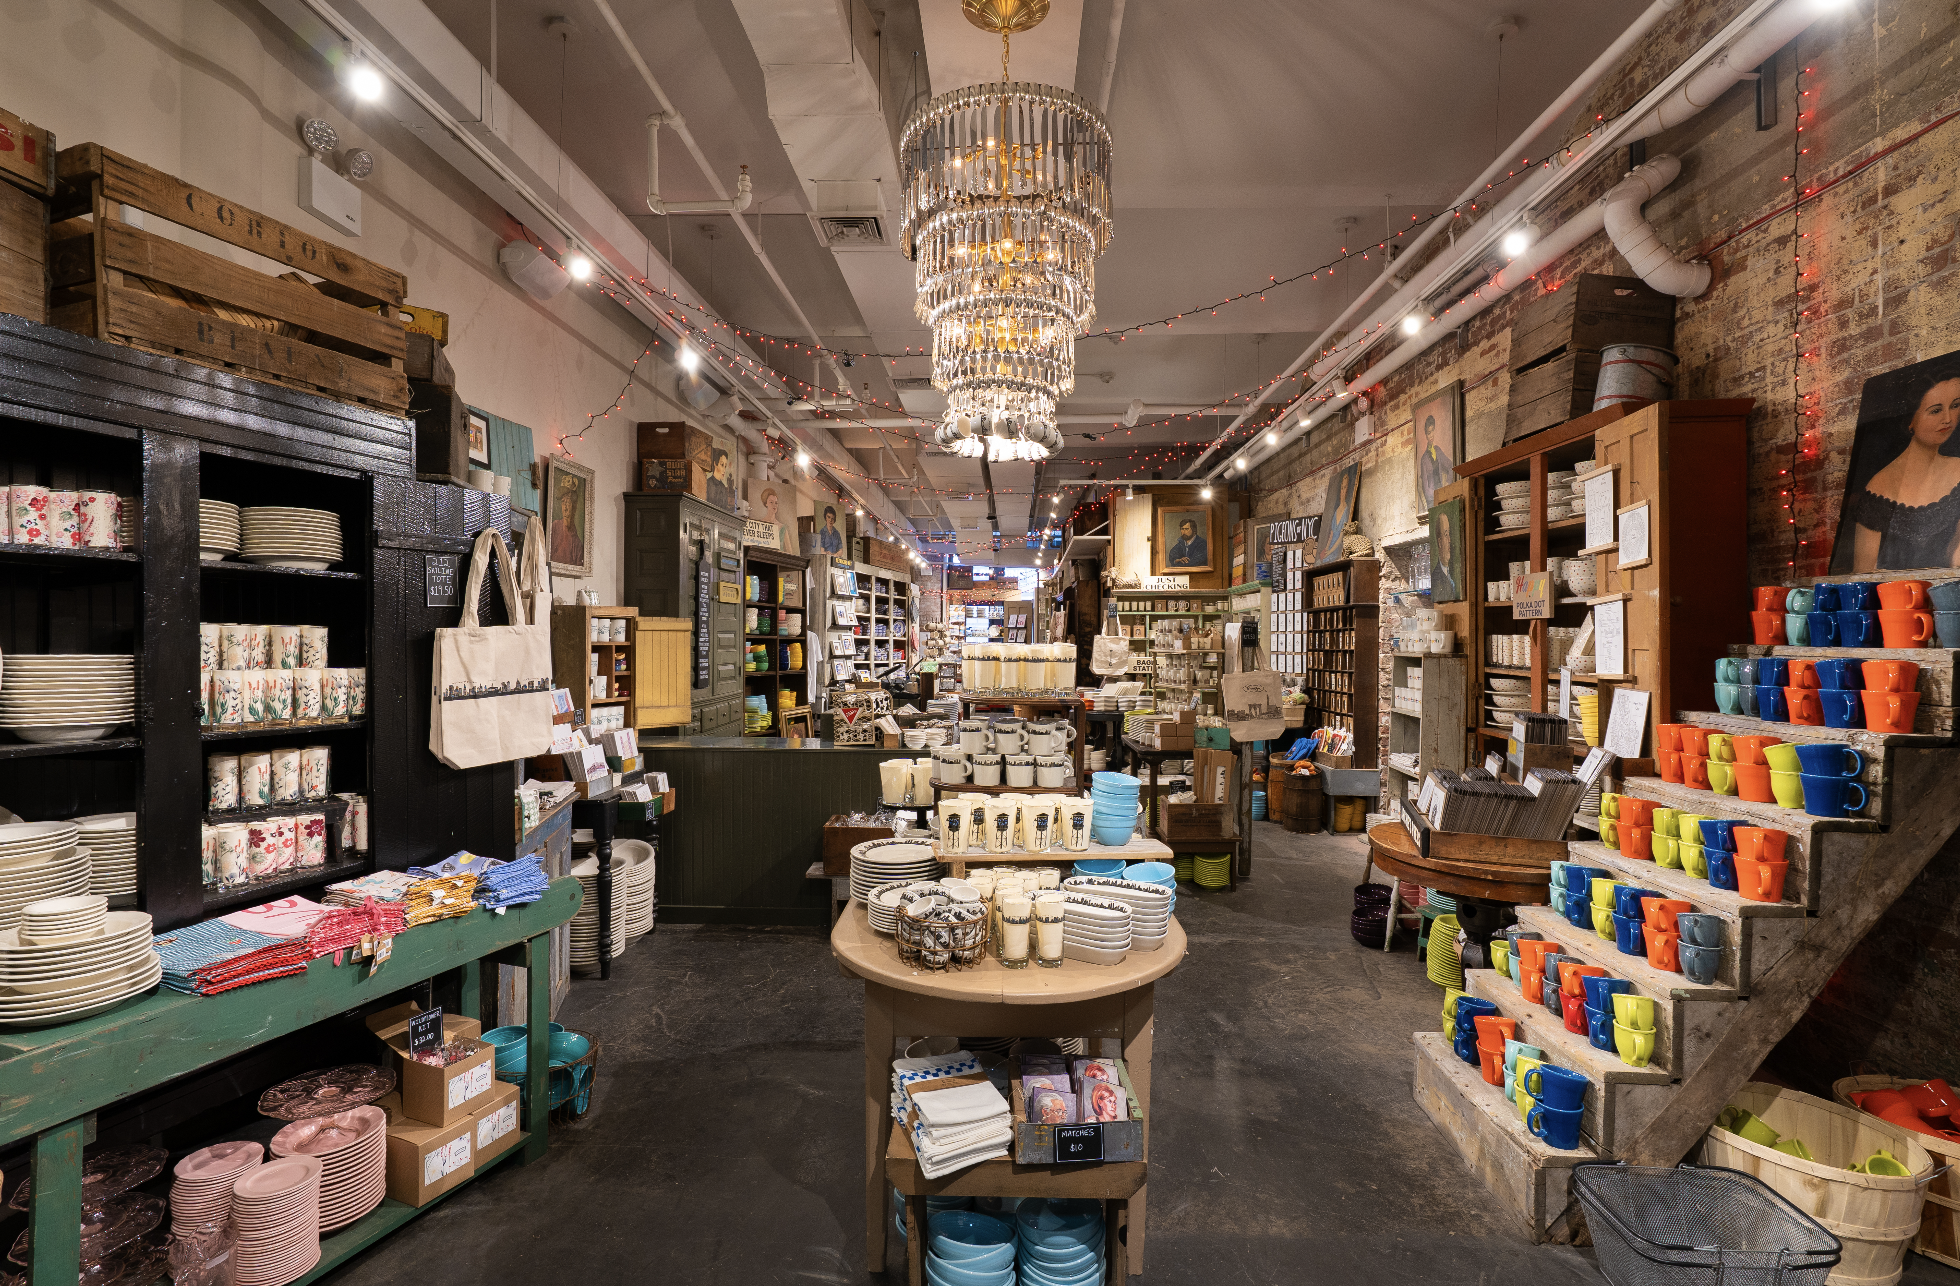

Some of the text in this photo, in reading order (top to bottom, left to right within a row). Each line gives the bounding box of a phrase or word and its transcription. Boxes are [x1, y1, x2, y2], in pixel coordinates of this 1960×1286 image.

[666, 461, 685, 469] BLUE
[666, 469, 686, 477] STAR
[748, 520, 760, 530] CITY
[761, 523, 774, 532] THAT
[1269, 520, 1299, 542] PIGEONS
[1301, 516, 1318, 541] NYC
[742, 529, 775, 540] EVER SLEEPS
[431, 575, 452, 583] TOTE
[430, 585, 454, 596] $19.50
[1515, 575, 1546, 598] Happy
[1516, 600, 1546, 610] POLKA DOT
[1518, 609, 1543, 618] PATTERN
[418, 1021, 431, 1032] KIT
[1061, 1128, 1095, 1138] MATCHES
[1069, 1142, 1084, 1152] $10
